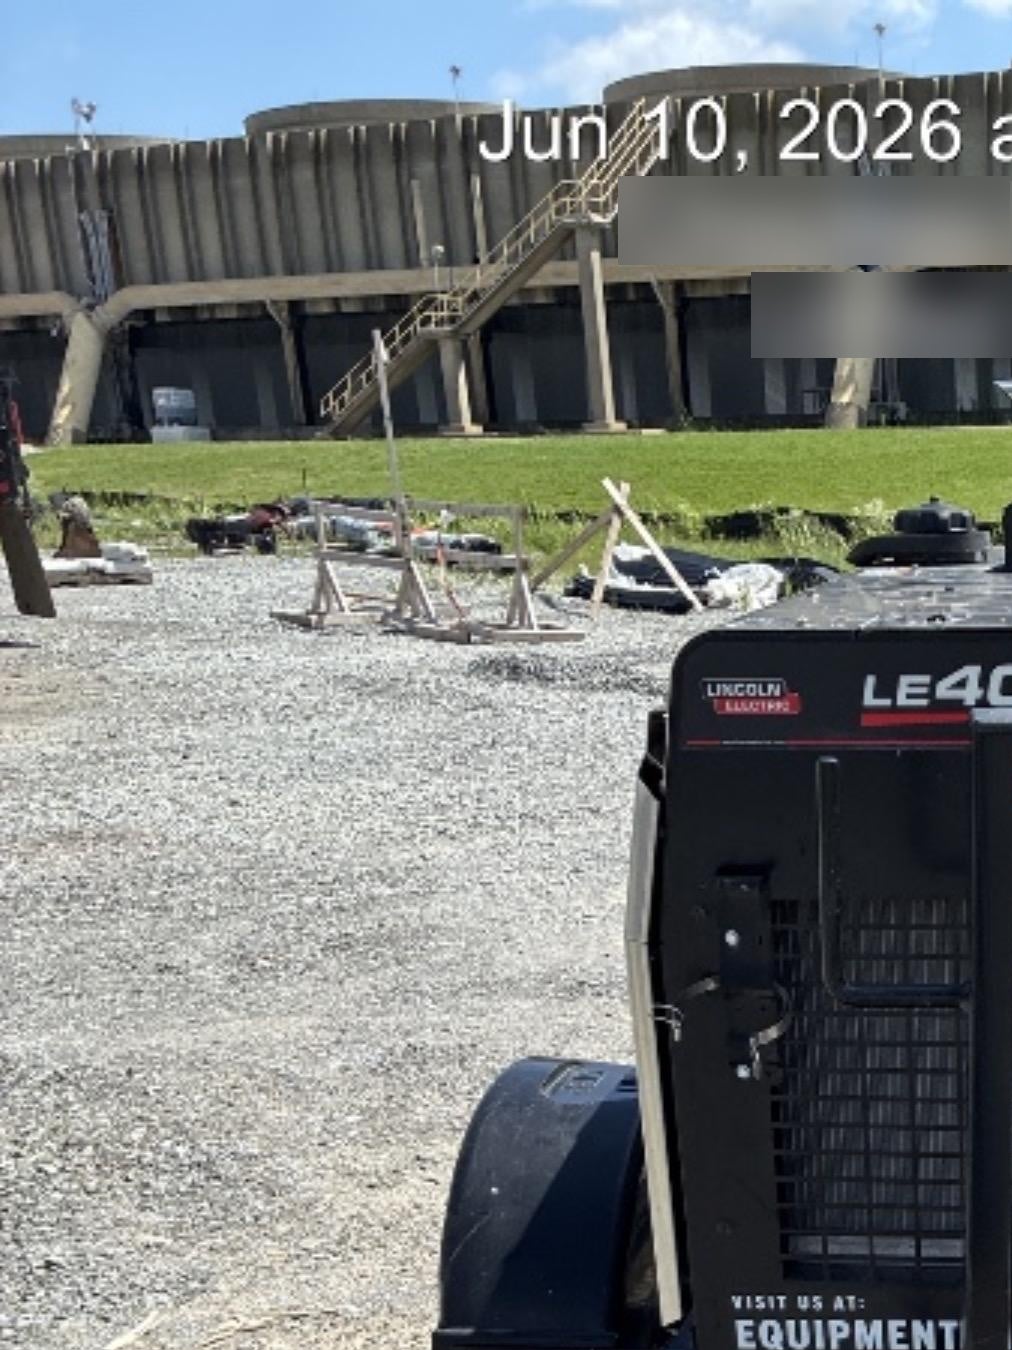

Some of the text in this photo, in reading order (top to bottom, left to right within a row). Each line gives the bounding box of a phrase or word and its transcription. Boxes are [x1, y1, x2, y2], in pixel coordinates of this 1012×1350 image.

[706, 683, 782, 697] LINCOLN
[731, 1295, 865, 1312] VISIT US AT:
